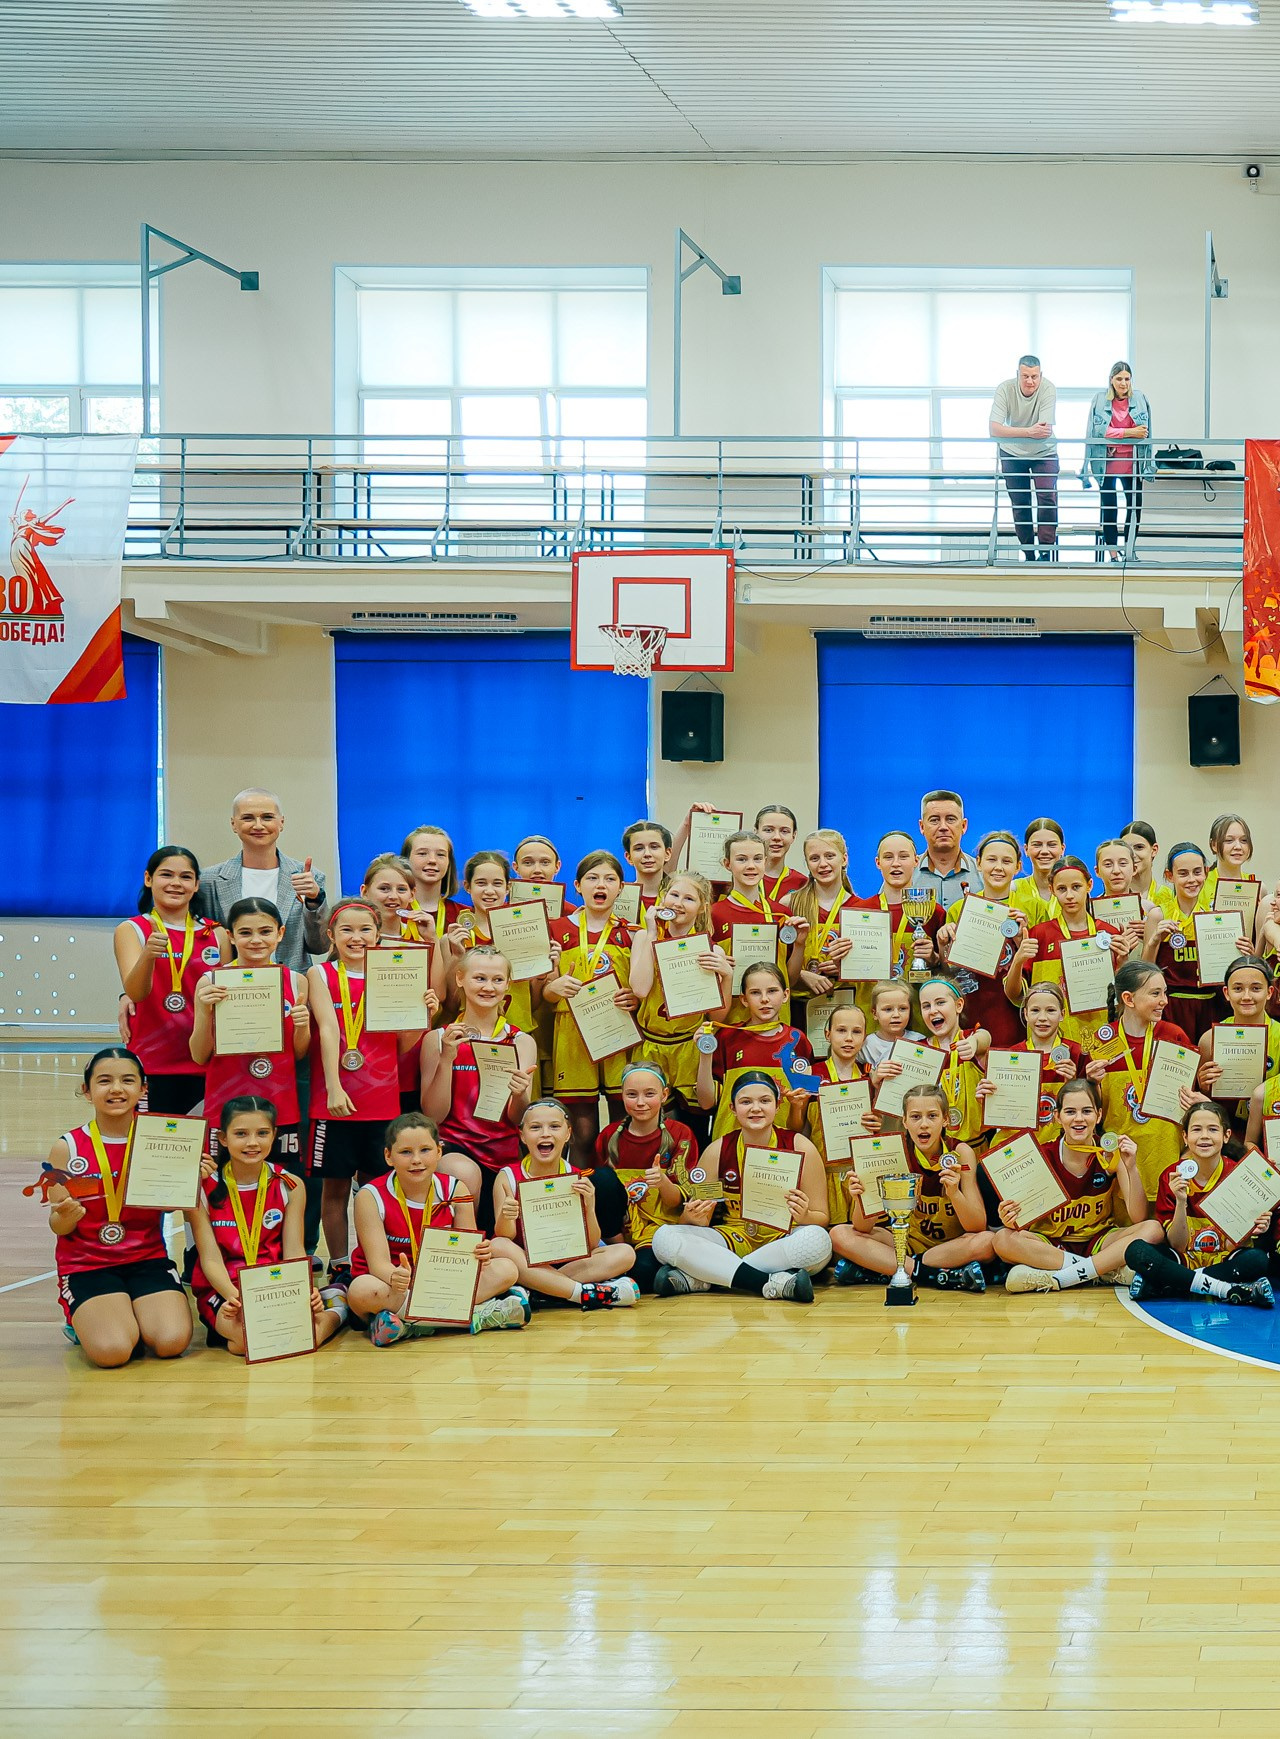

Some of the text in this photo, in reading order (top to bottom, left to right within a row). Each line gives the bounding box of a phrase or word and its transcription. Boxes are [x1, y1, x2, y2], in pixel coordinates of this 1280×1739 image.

[502, 924, 538, 937] ДИПЛОМ
[1205, 932, 1236, 941] ДИПЛОМ
[669, 958, 699, 970] ДИПЛО
[1072, 957, 1104, 968] ДИПЛОМ
[377, 972, 418, 981] ДИПЛОМ
[226, 992, 270, 1001] ДИПЛОМ
[1160, 1063, 1190, 1078] ДИПЛОМ
[995, 1073, 1031, 1082] ДИПЛОМ
[829, 1103, 863, 1114] ДИПЛОМ
[145, 1142, 192, 1152] ДИПЛОМ
[280, 1133, 299, 1154] 15
[862, 1158, 898, 1169] ДИПЛОМ
[1001, 1157, 1035, 1182] ДИПЛОМ
[752, 1171, 789, 1182] ДИПЛОМ
[1240, 1173, 1270, 1202] ДИПЛОМ
[532, 1200, 572, 1212] ДИПЛОМ
[1096, 1200, 1104, 1215] 5
[428, 1254, 469, 1266] ДИПЛОМ
[254, 1288, 300, 1304] ДИПЛОМ
